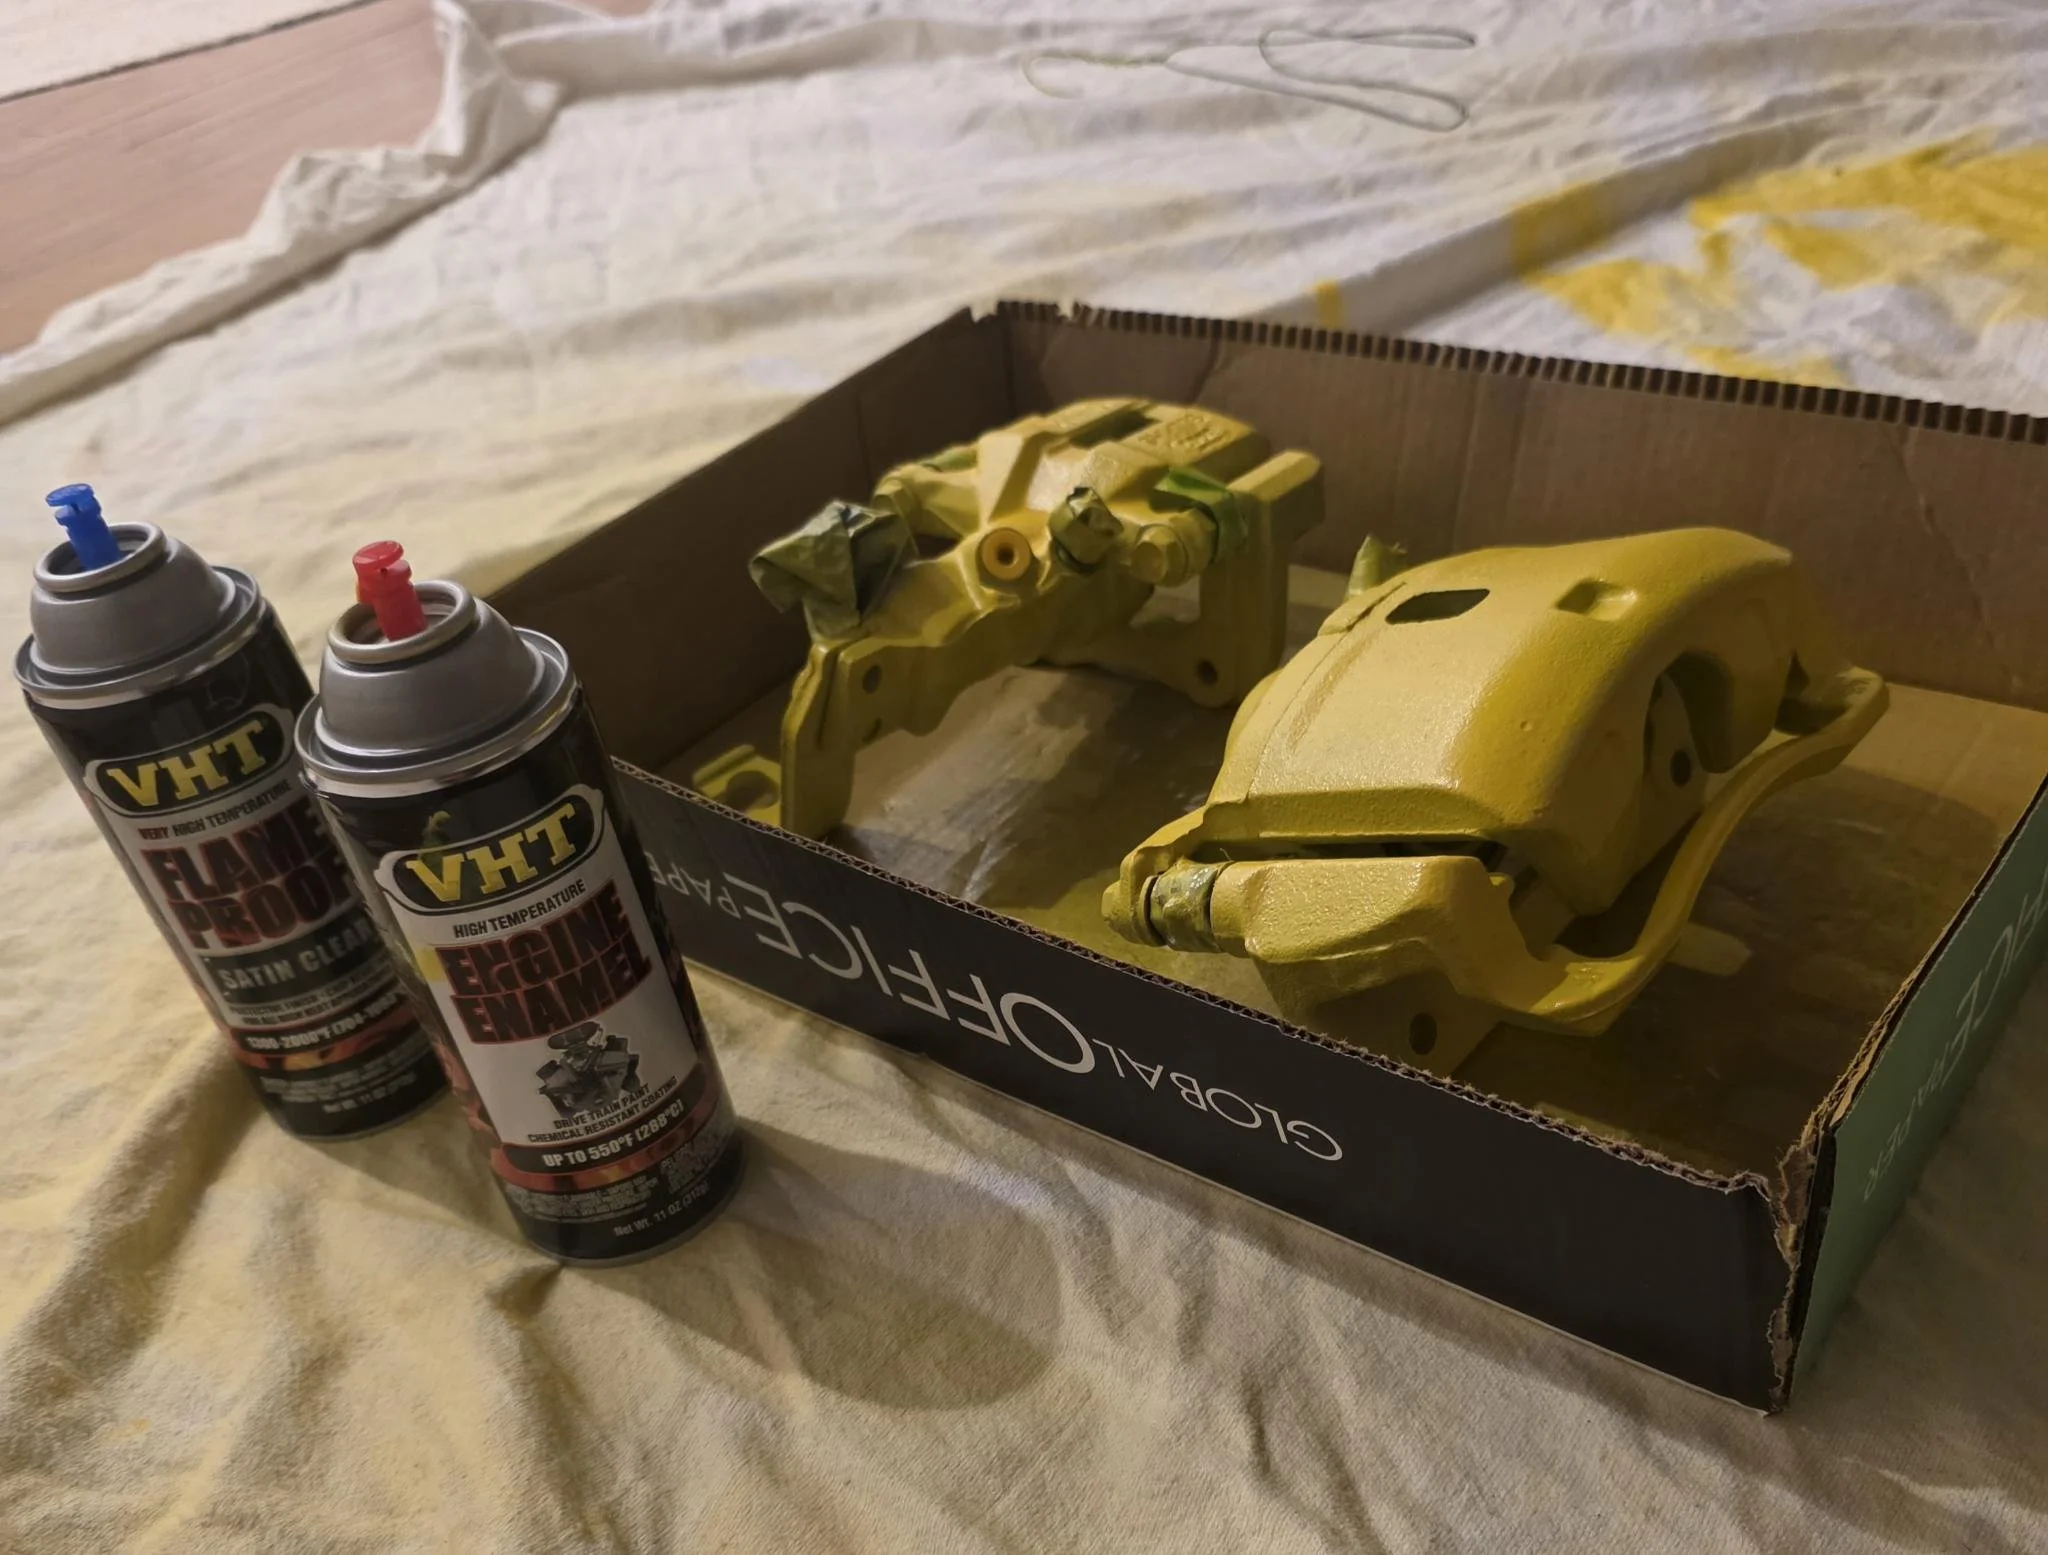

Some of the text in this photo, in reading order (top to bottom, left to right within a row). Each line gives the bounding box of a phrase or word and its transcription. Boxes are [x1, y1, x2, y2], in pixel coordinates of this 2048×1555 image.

[106, 719, 267, 808] VHT
[138, 779, 293, 840] VERY HIGH TEMPERATURE
[140, 796, 336, 901] FLAME
[404, 802, 577, 903] VHT
[167, 851, 353, 950] PROOF
[435, 876, 631, 997] ENGINE
[453, 879, 587, 938] HIGH TEMPERATURE
[218, 959, 297, 990] SATIN
[298, 918, 376, 973] CLEAR
[450, 930, 652, 1044] ENAMEL
[1941, 862, 2048, 1088] FICE
[643, 850, 1343, 1161] GLOBAL OFFICE PAPE
[528, 1075, 679, 1143] CHEMICAL RESISTANT COATING
[542, 1153, 564, 1168] UP
[564, 1149, 588, 1165] TO
[588, 1131, 634, 1161] 550°F
[554, 1083, 650, 1129] DRIVE TRAIN PAINT
